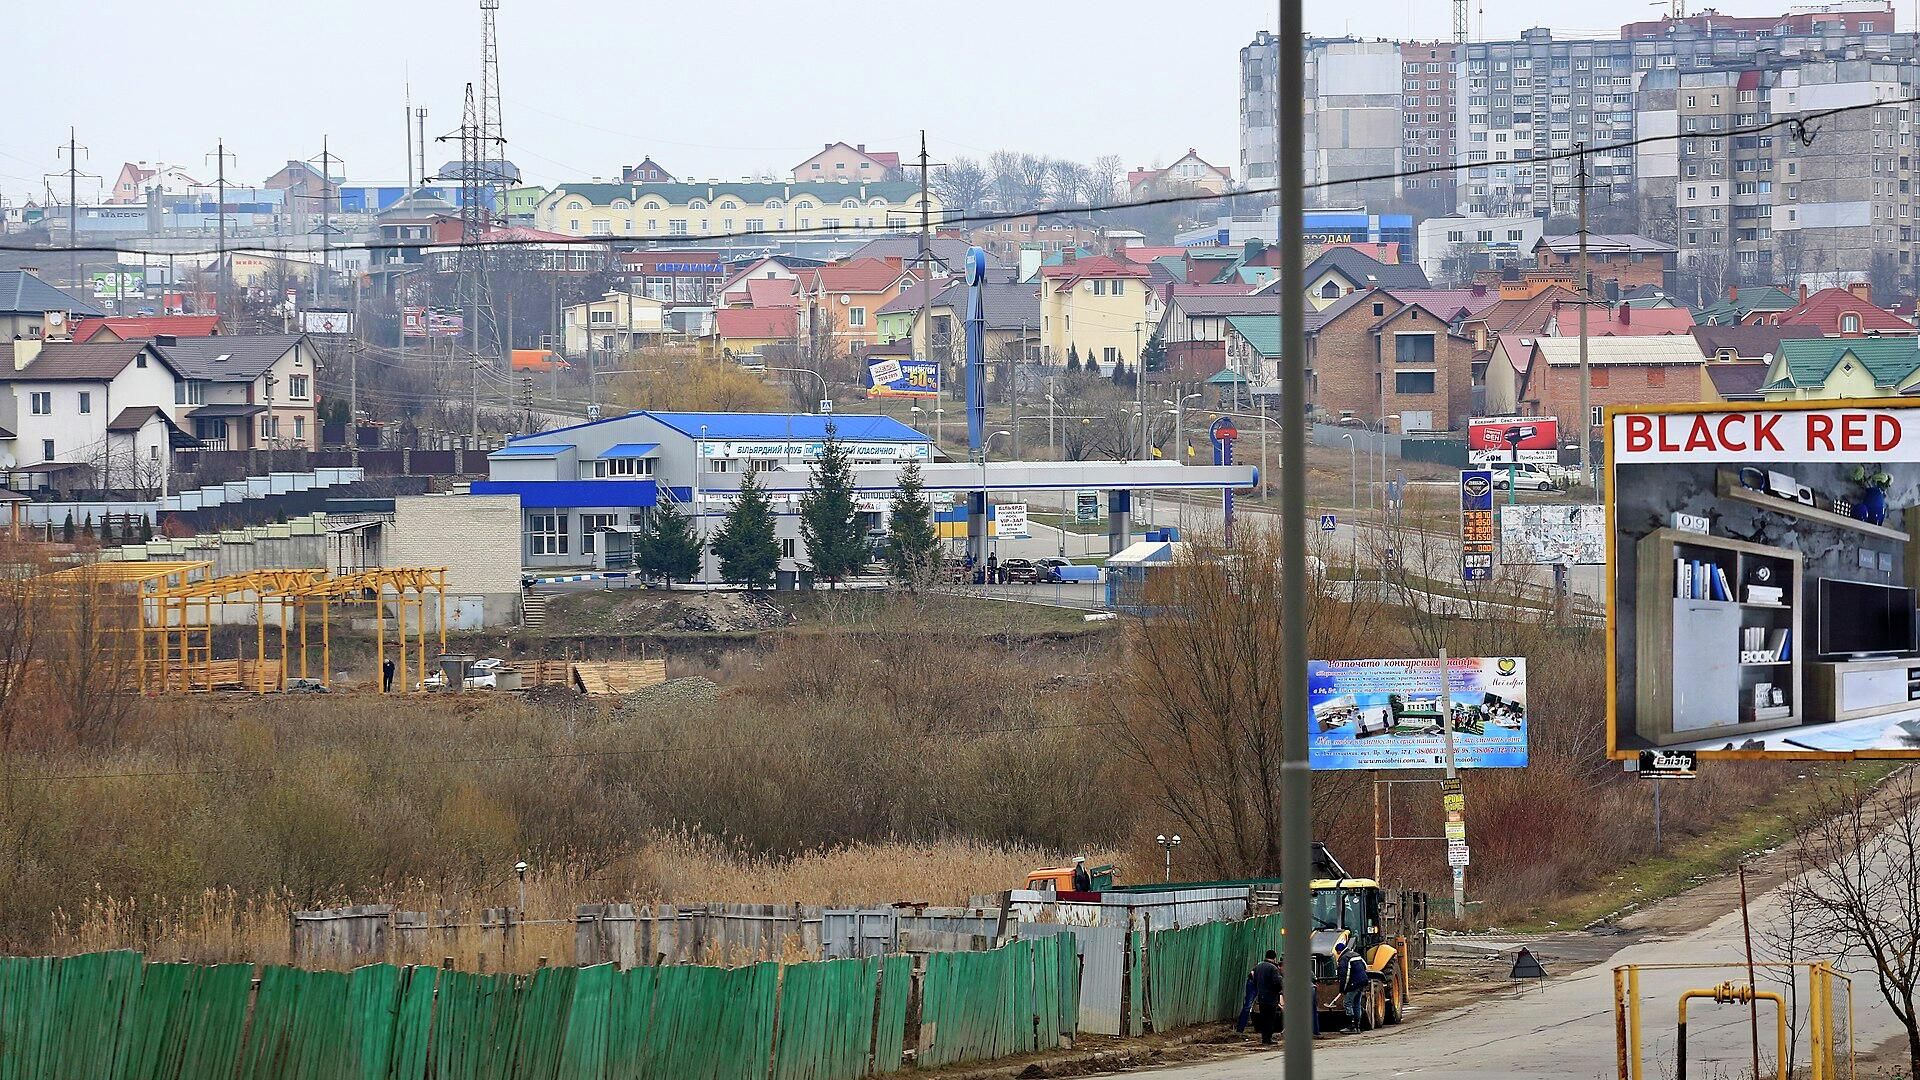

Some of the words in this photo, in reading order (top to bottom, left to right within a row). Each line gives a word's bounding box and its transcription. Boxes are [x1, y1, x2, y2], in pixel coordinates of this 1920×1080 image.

[1626, 414, 1785, 452] BLACK
[1806, 413, 1902, 452] RED
[737, 446, 783, 454] БІЛЬЯРДНИЙ
[784, 446, 803, 454] КЛУБ
[1741, 650, 1775, 663] BOOK
